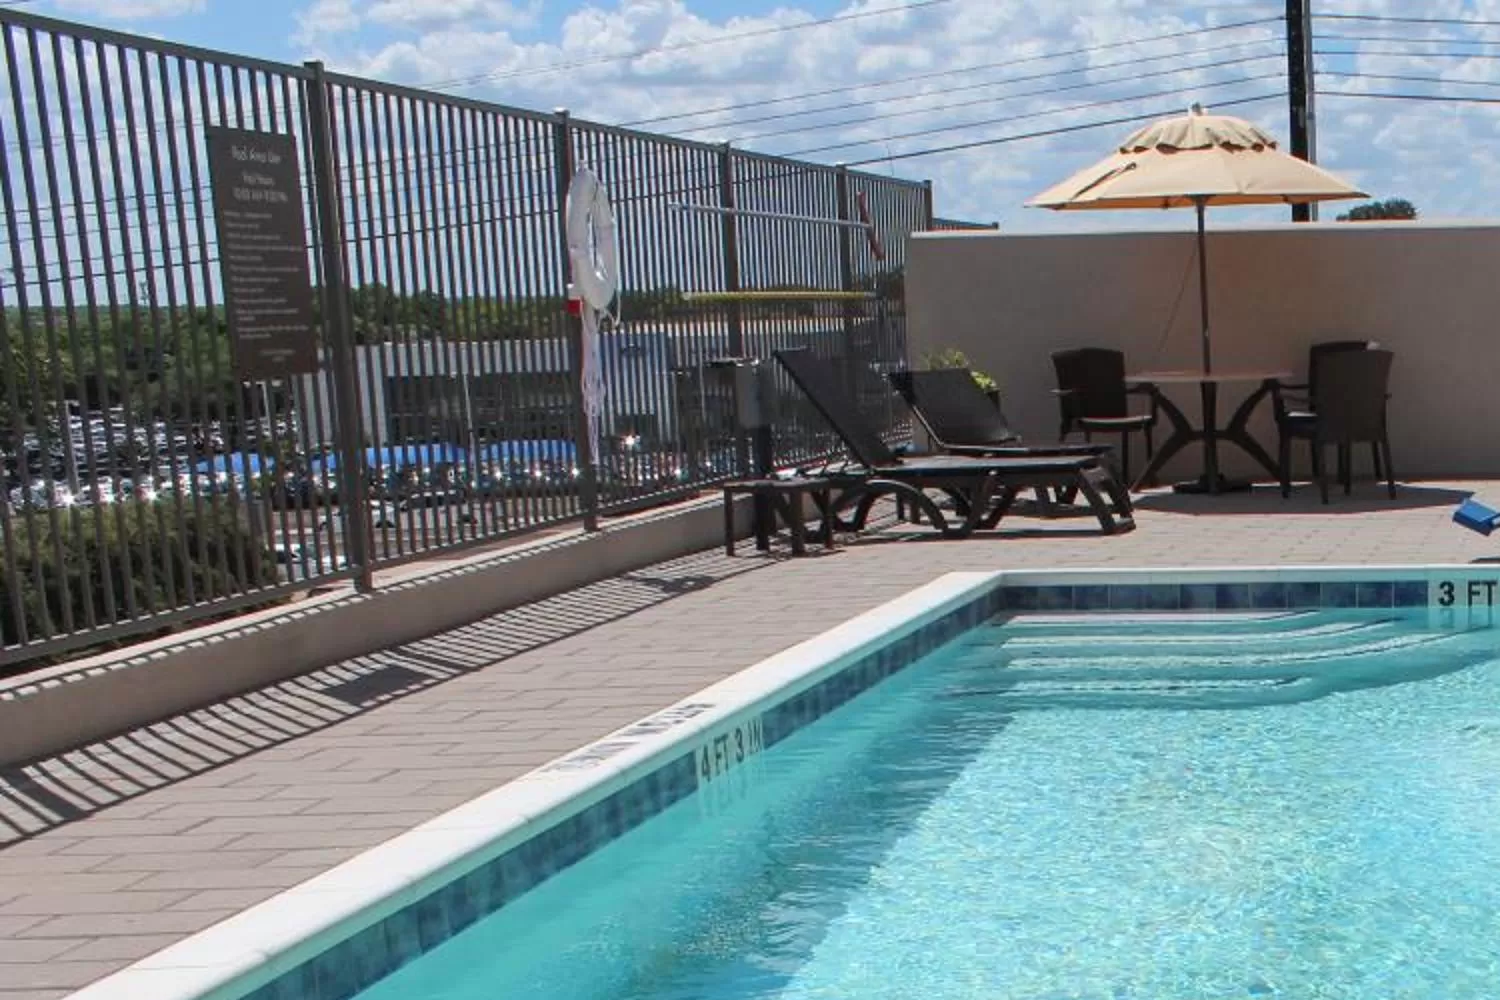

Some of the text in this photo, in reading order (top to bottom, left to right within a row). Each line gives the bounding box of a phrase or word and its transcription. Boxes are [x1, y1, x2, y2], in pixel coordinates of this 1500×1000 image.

[1438, 581, 1455, 606] 3
[1467, 580, 1497, 606] FT
[702, 744, 711, 782] 4
[713, 732, 729, 777] FT
[735, 727, 744, 763] 3
[748, 718, 763, 757] IN
